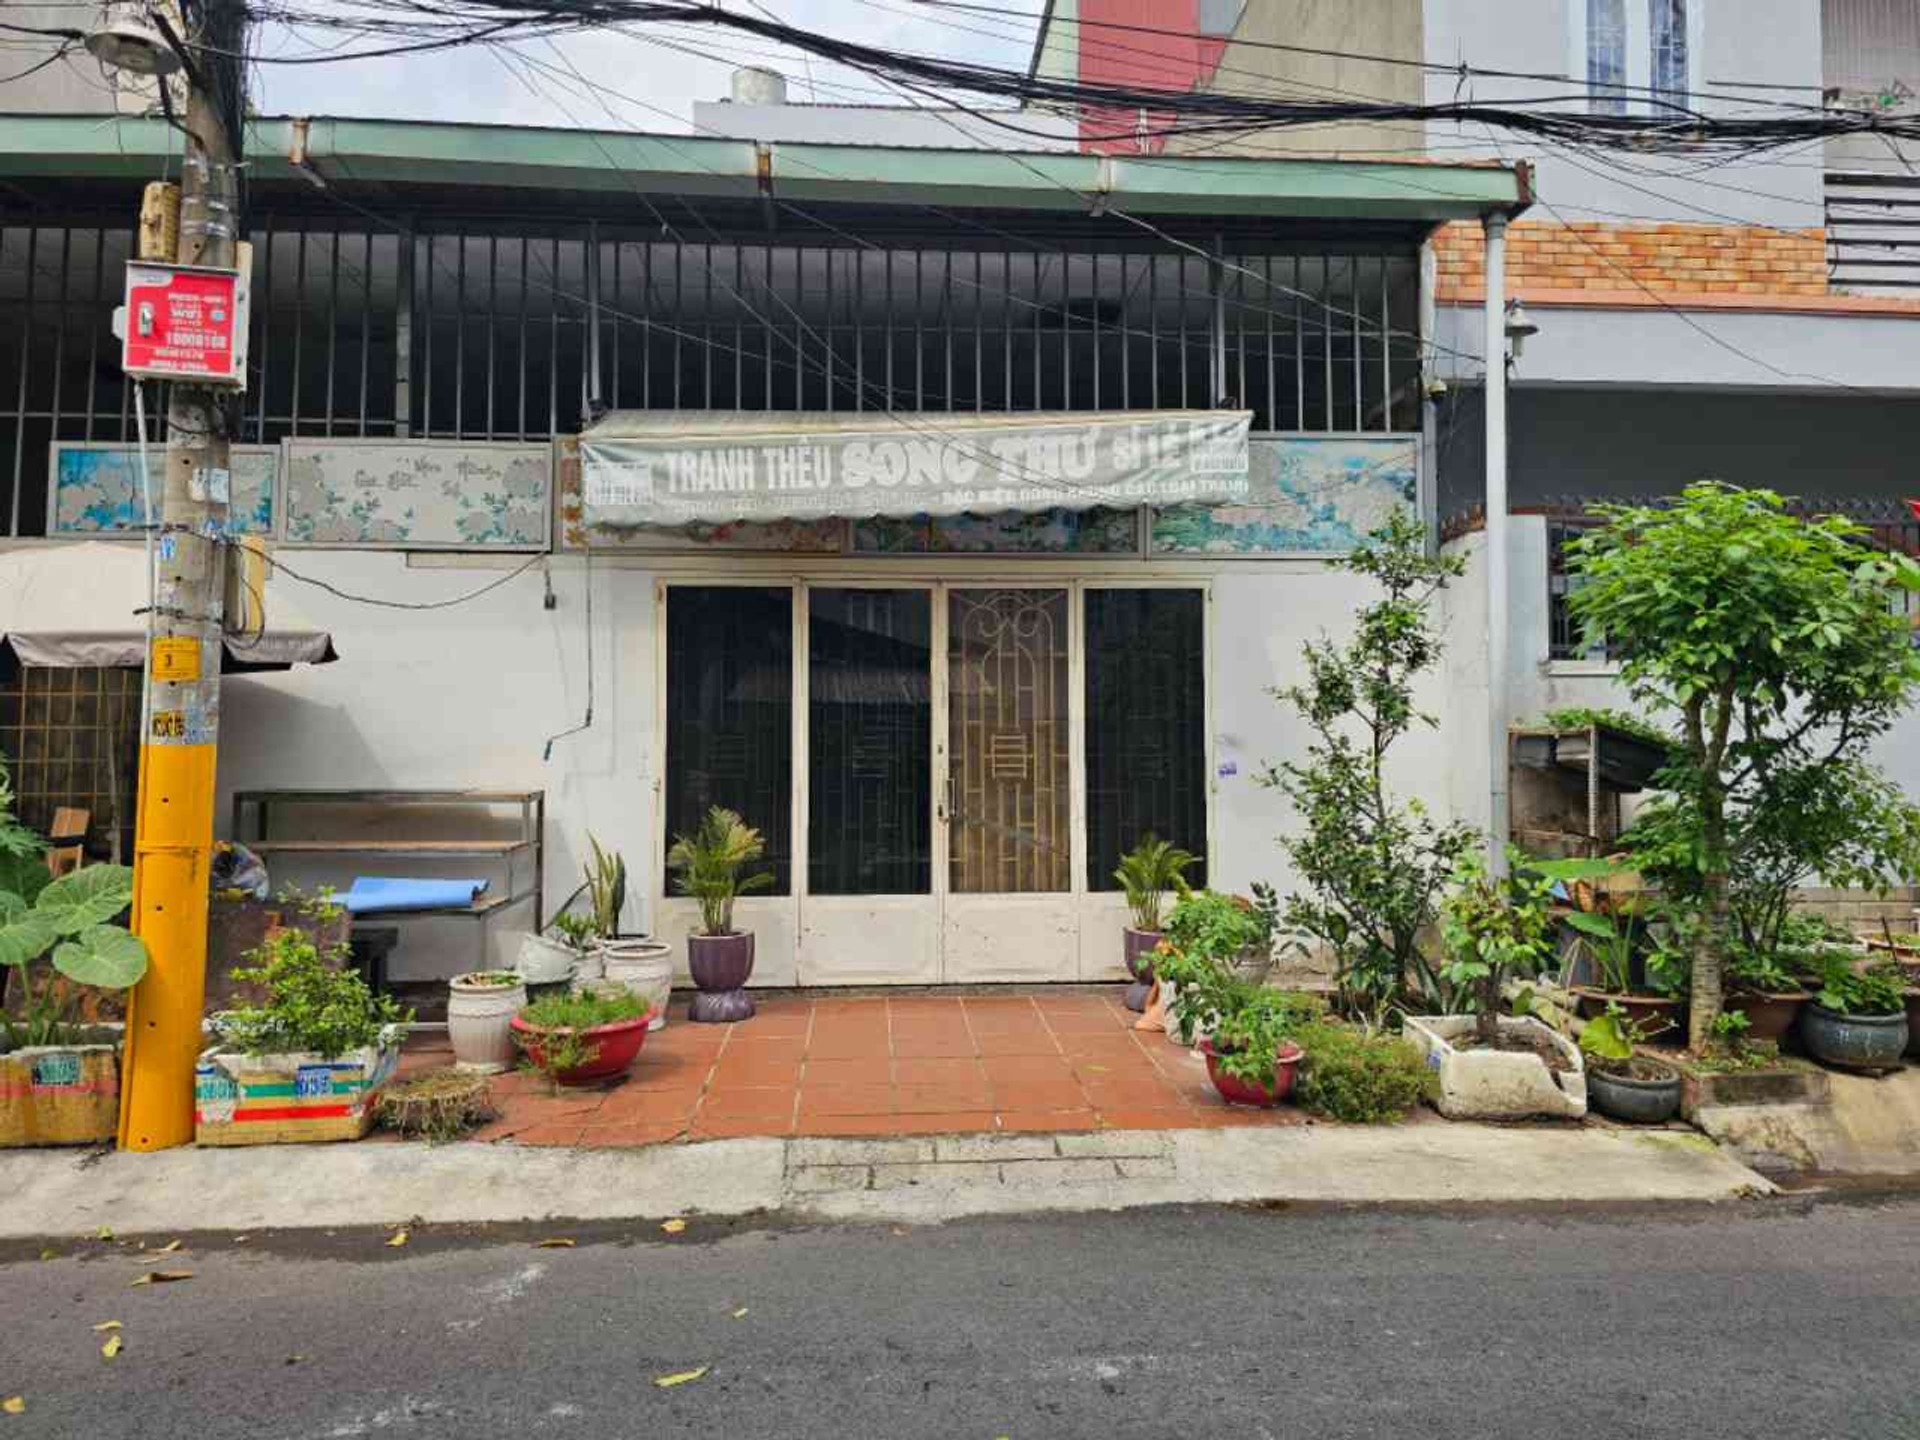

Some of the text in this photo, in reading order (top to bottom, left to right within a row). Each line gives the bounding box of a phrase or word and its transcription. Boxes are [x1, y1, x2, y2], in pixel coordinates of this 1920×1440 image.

[664, 449, 752, 493] TRANH
[763, 434, 830, 489] THÊU
[841, 440, 980, 487] SONG
